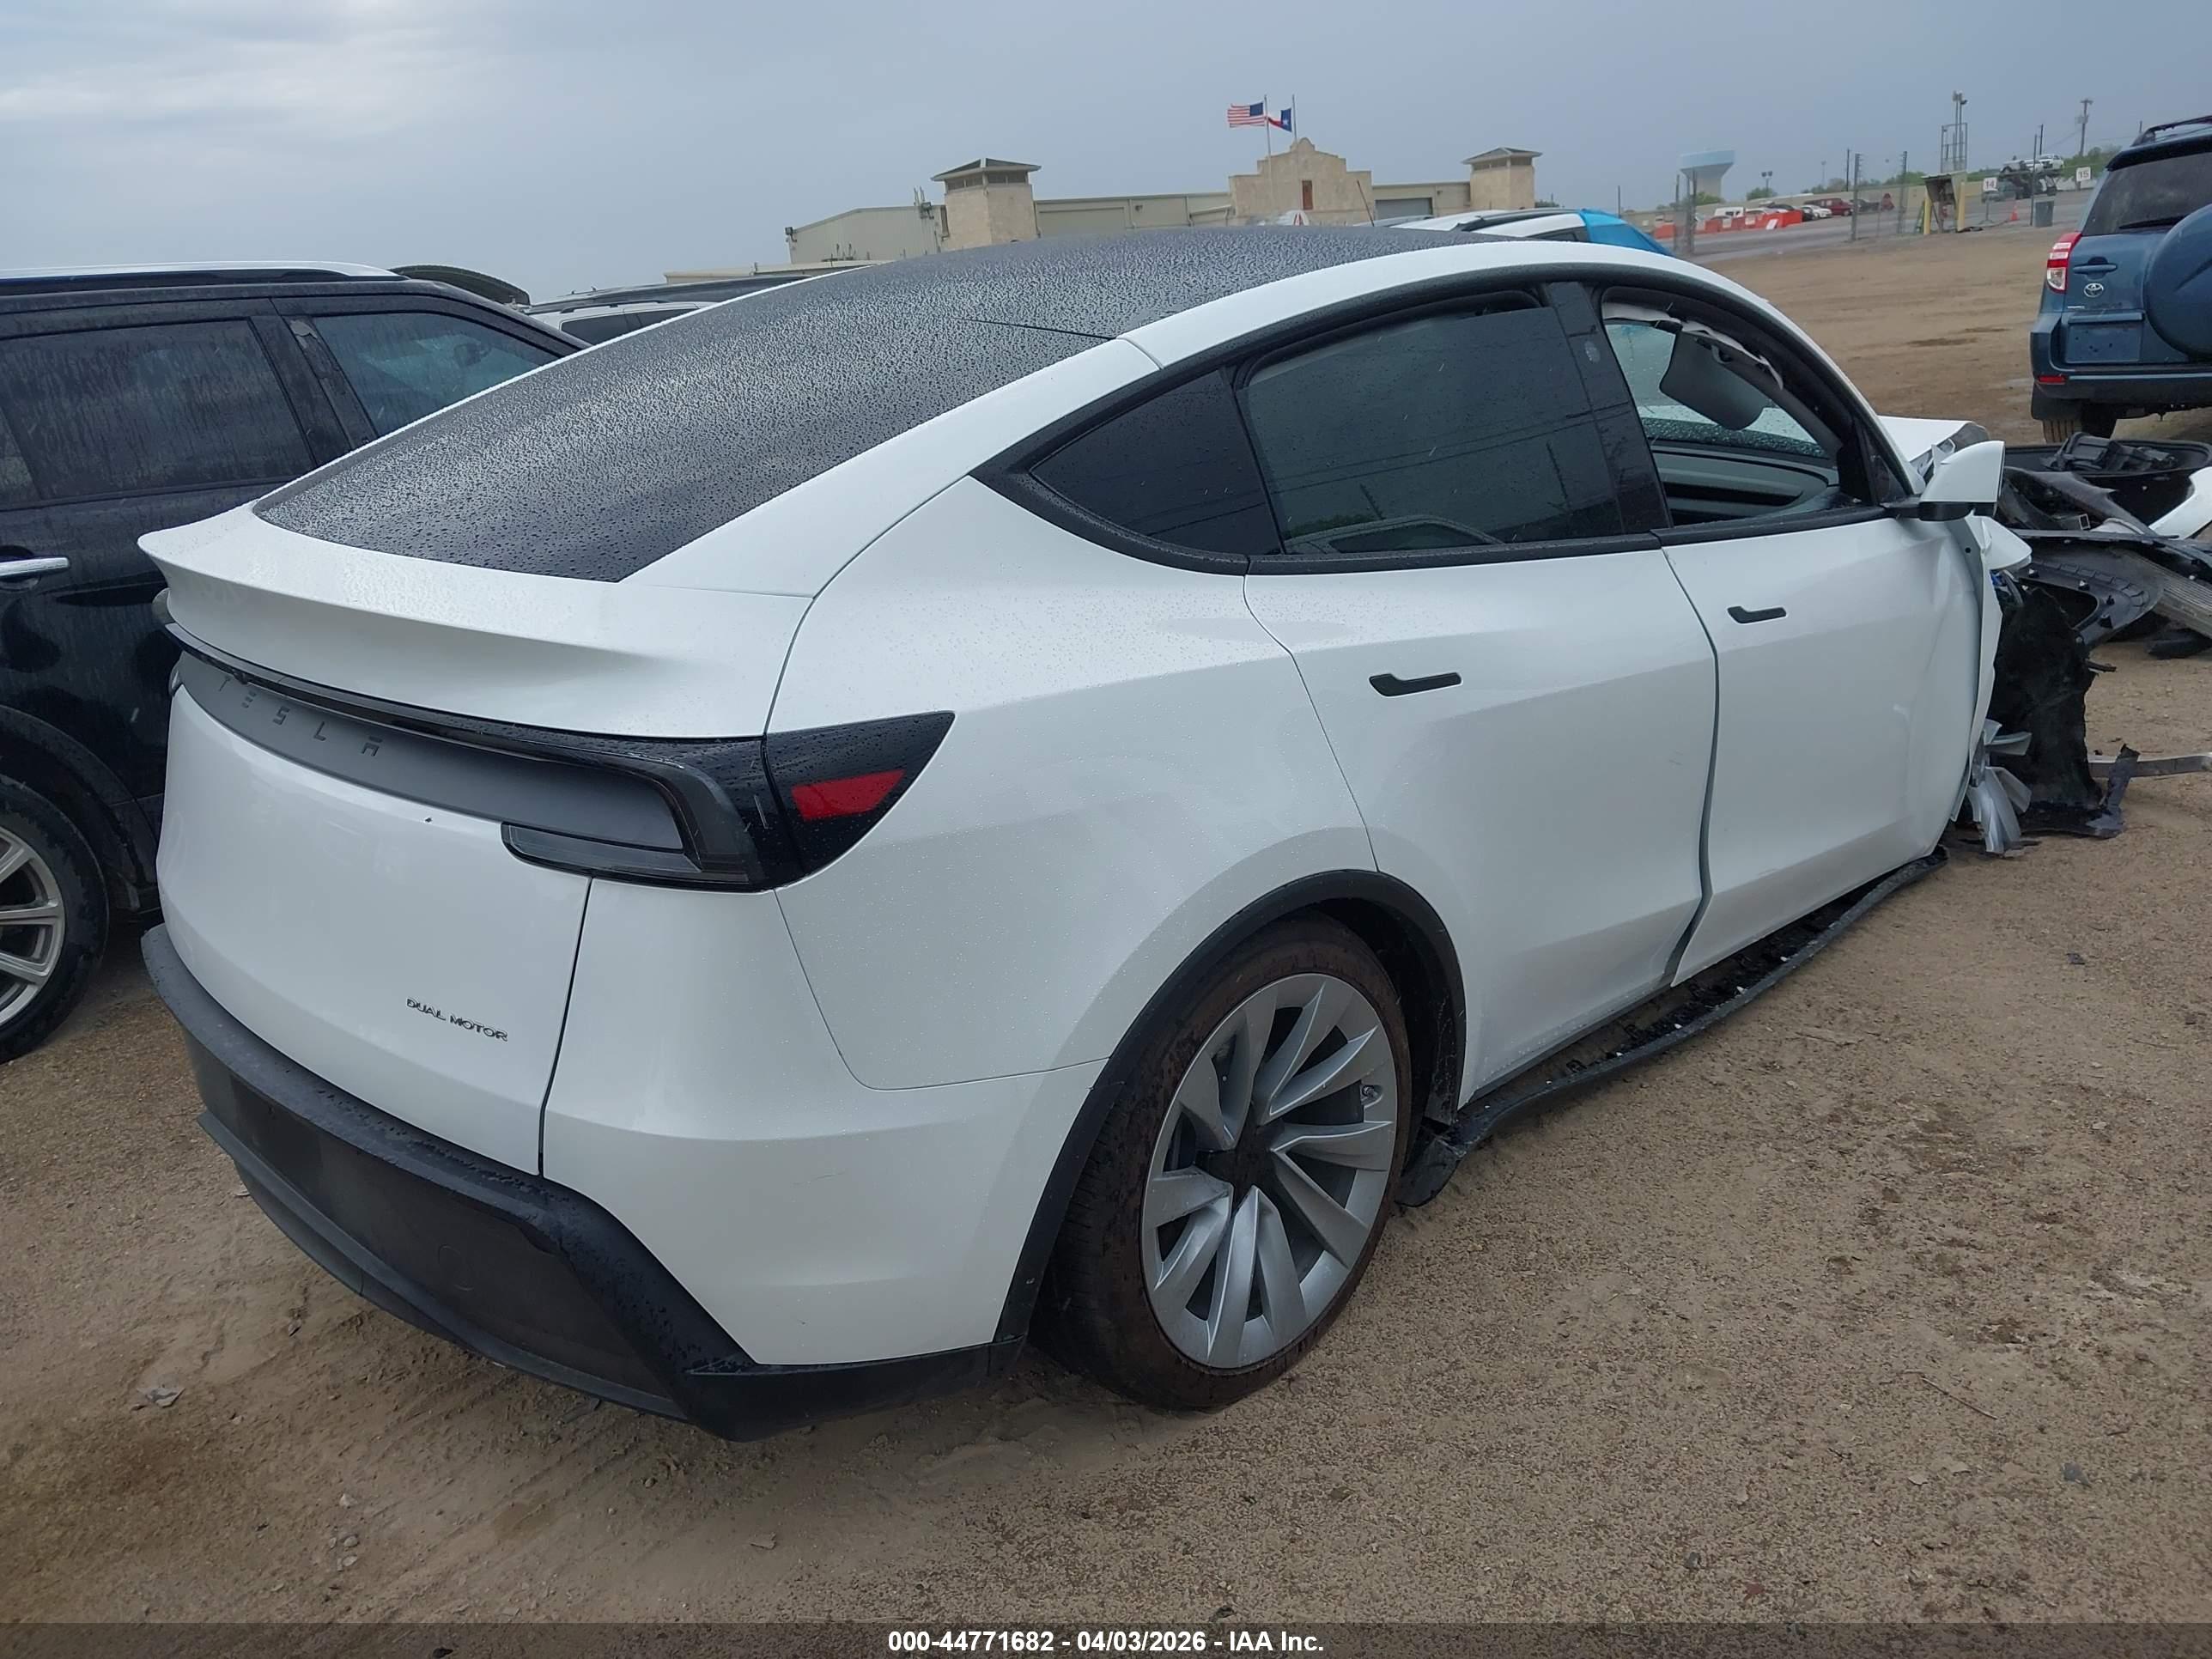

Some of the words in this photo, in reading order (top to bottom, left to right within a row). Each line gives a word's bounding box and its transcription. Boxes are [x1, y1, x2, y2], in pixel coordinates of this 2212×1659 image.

[218, 675, 383, 757] TESLA
[406, 998, 447, 1021] DUAL
[450, 1014, 508, 1042] MOTOR
